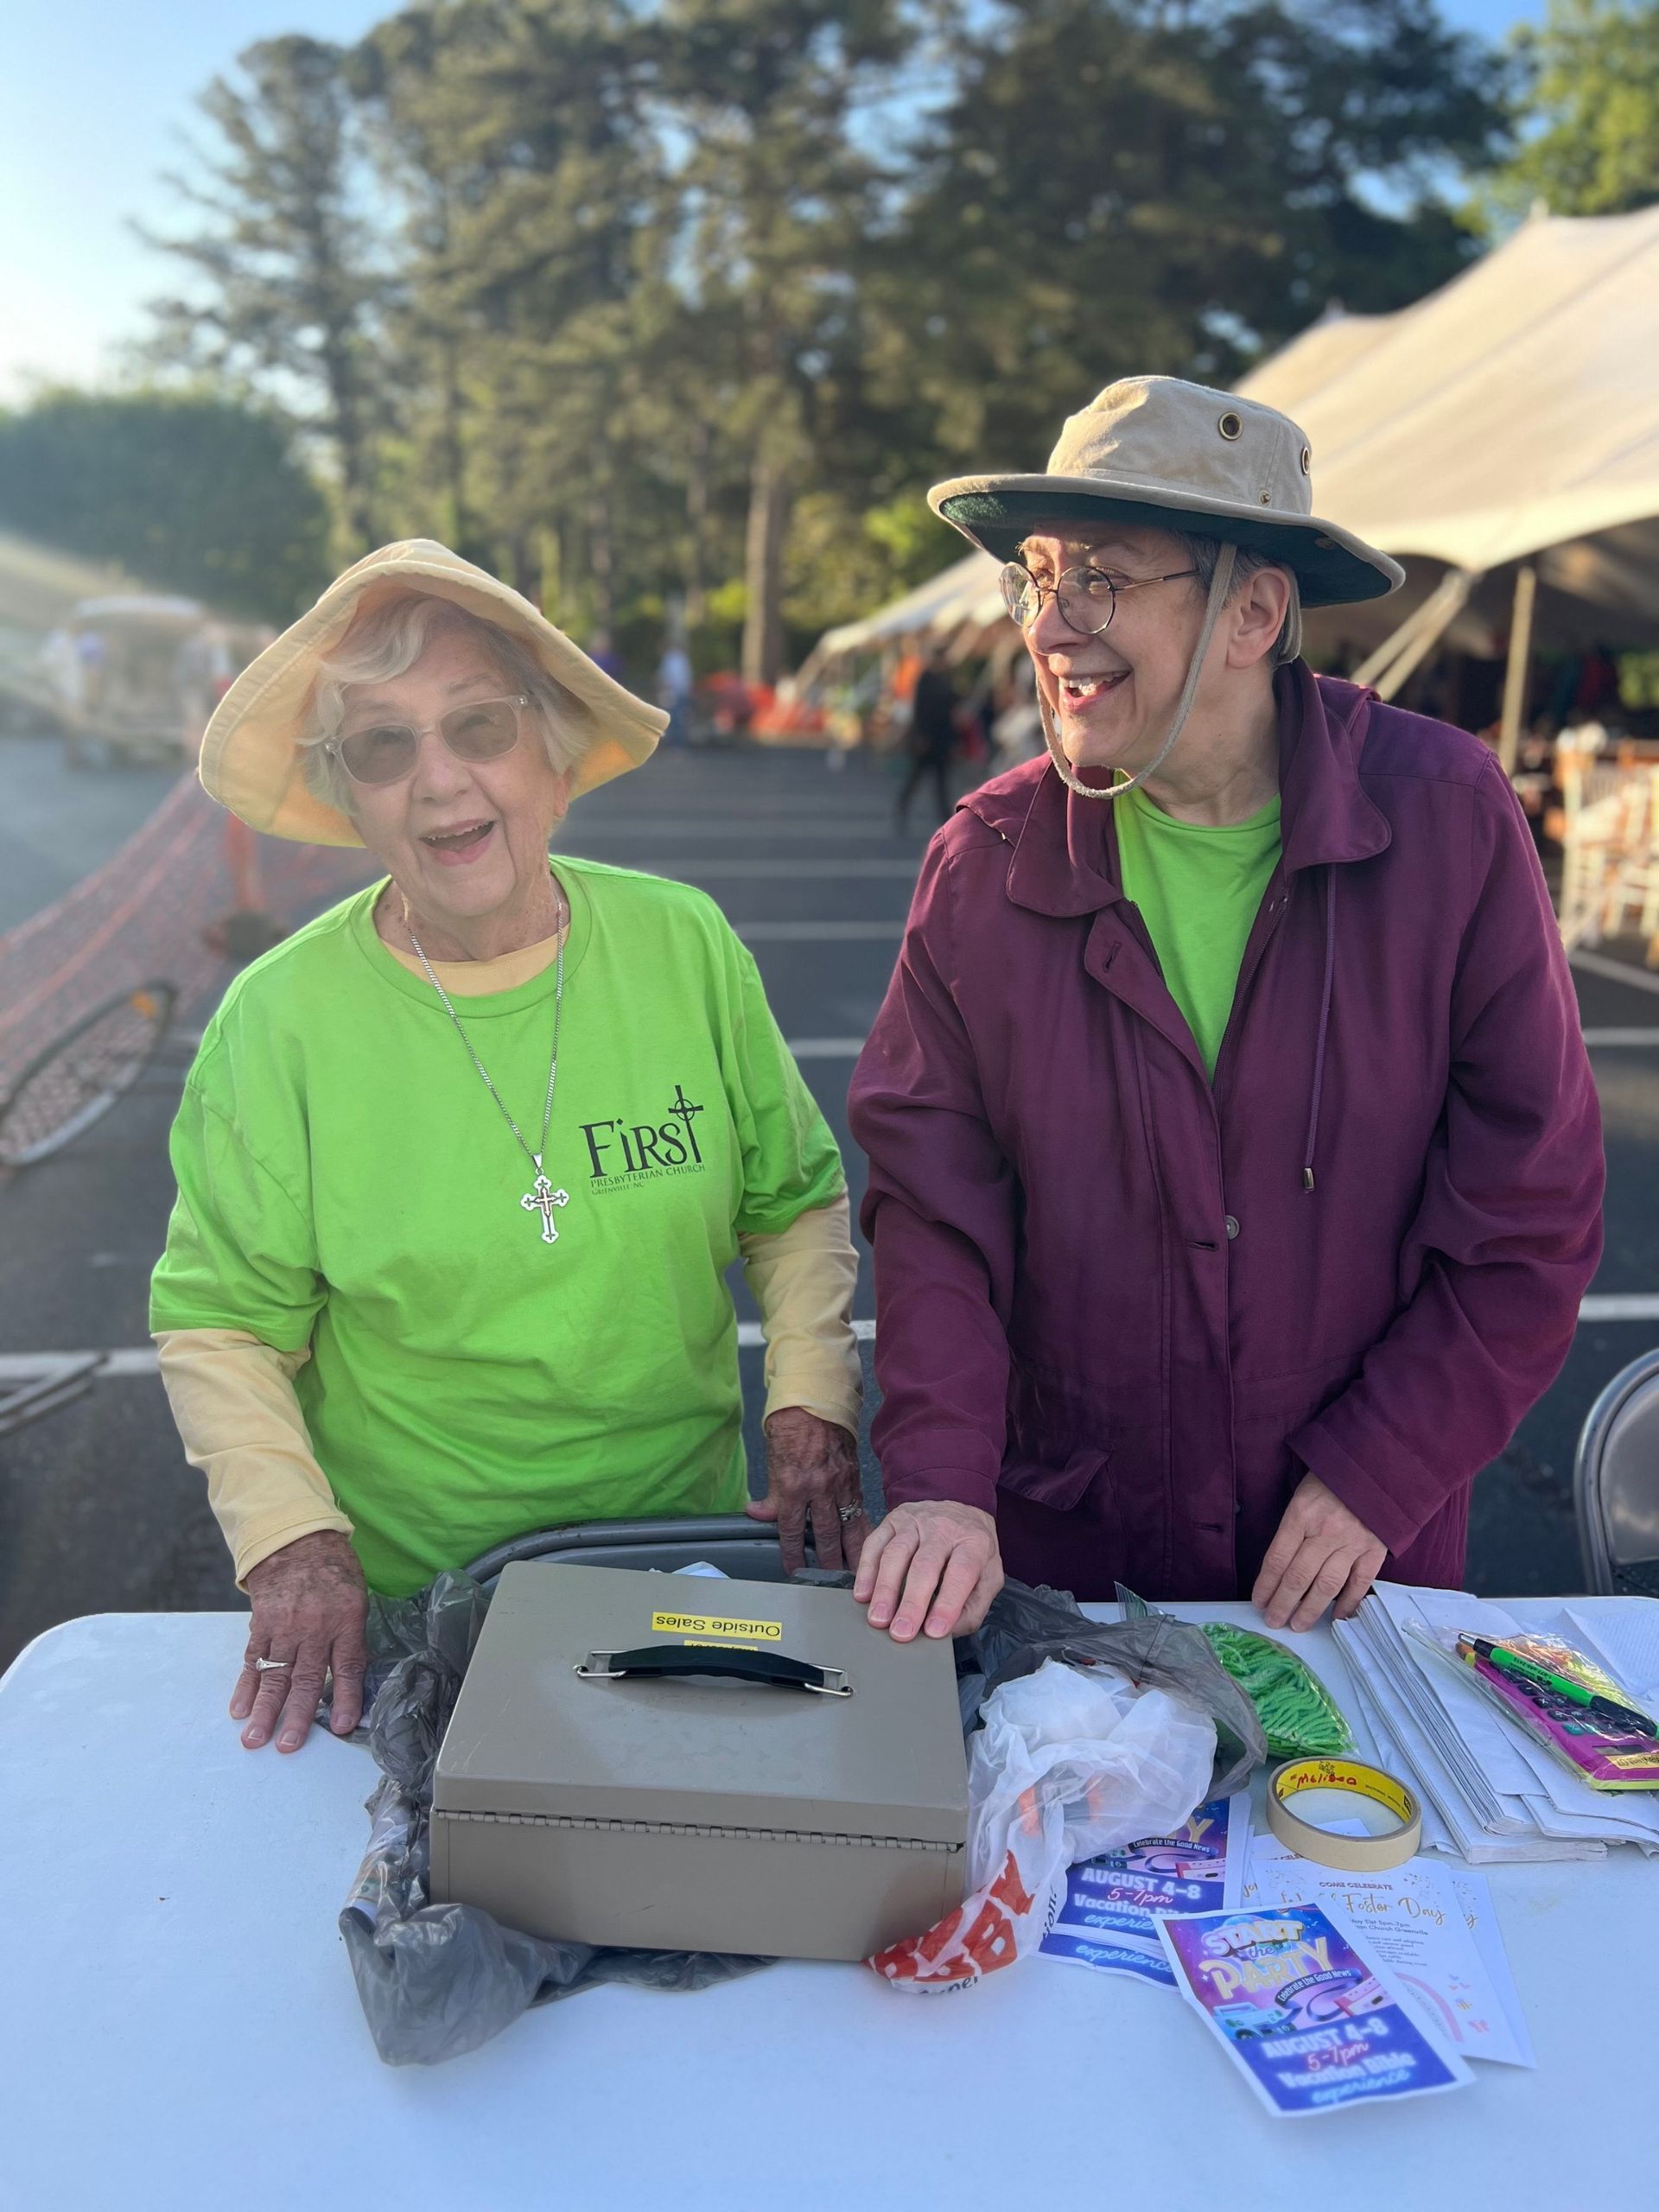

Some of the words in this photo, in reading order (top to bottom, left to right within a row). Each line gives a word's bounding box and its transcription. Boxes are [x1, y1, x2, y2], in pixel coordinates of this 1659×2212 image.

[590, 1169, 664, 1188] PRESBYTERIAN
[666, 1164, 706, 1176] CHURCH
[656, 1616, 706, 1630] Sales
[712, 1621, 780, 1637] Outside
[1133, 1839, 1162, 1848] Celebrate
[1176, 1840, 1192, 1849] Good
[1193, 1844, 1211, 1853] News
[1082, 1868, 1158, 1891] AUGUST
[1347, 1881, 1394, 1891] CELEBRATE
[1074, 1893, 1150, 1917] Vacation
[1107, 1888, 1173, 1906] 5-7pm
[1343, 1893, 1393, 1913] Foster
[1397, 1897, 1447, 1925] Day
[1084, 1914, 1155, 1930] experie
[1394, 1927, 1429, 1936] Greenville
[1204, 1921, 1304, 1956] START
[1249, 1945, 1275, 1958] the
[1198, 1936, 1333, 1999] PARTY
[1277, 1980, 1305, 2001] Celebrate
[1303, 1976, 1315, 1987] the
[1314, 1971, 1332, 1982] Good
[1332, 1969, 1351, 1980] News
[1261, 2028, 1343, 2058] AUGUST
[1307, 2043, 1369, 2071] 5-7pm
[1277, 2065, 1367, 2088] Vacation
[1363, 2052, 1416, 2074] Bible
[1311, 2069, 1410, 2103] experience
